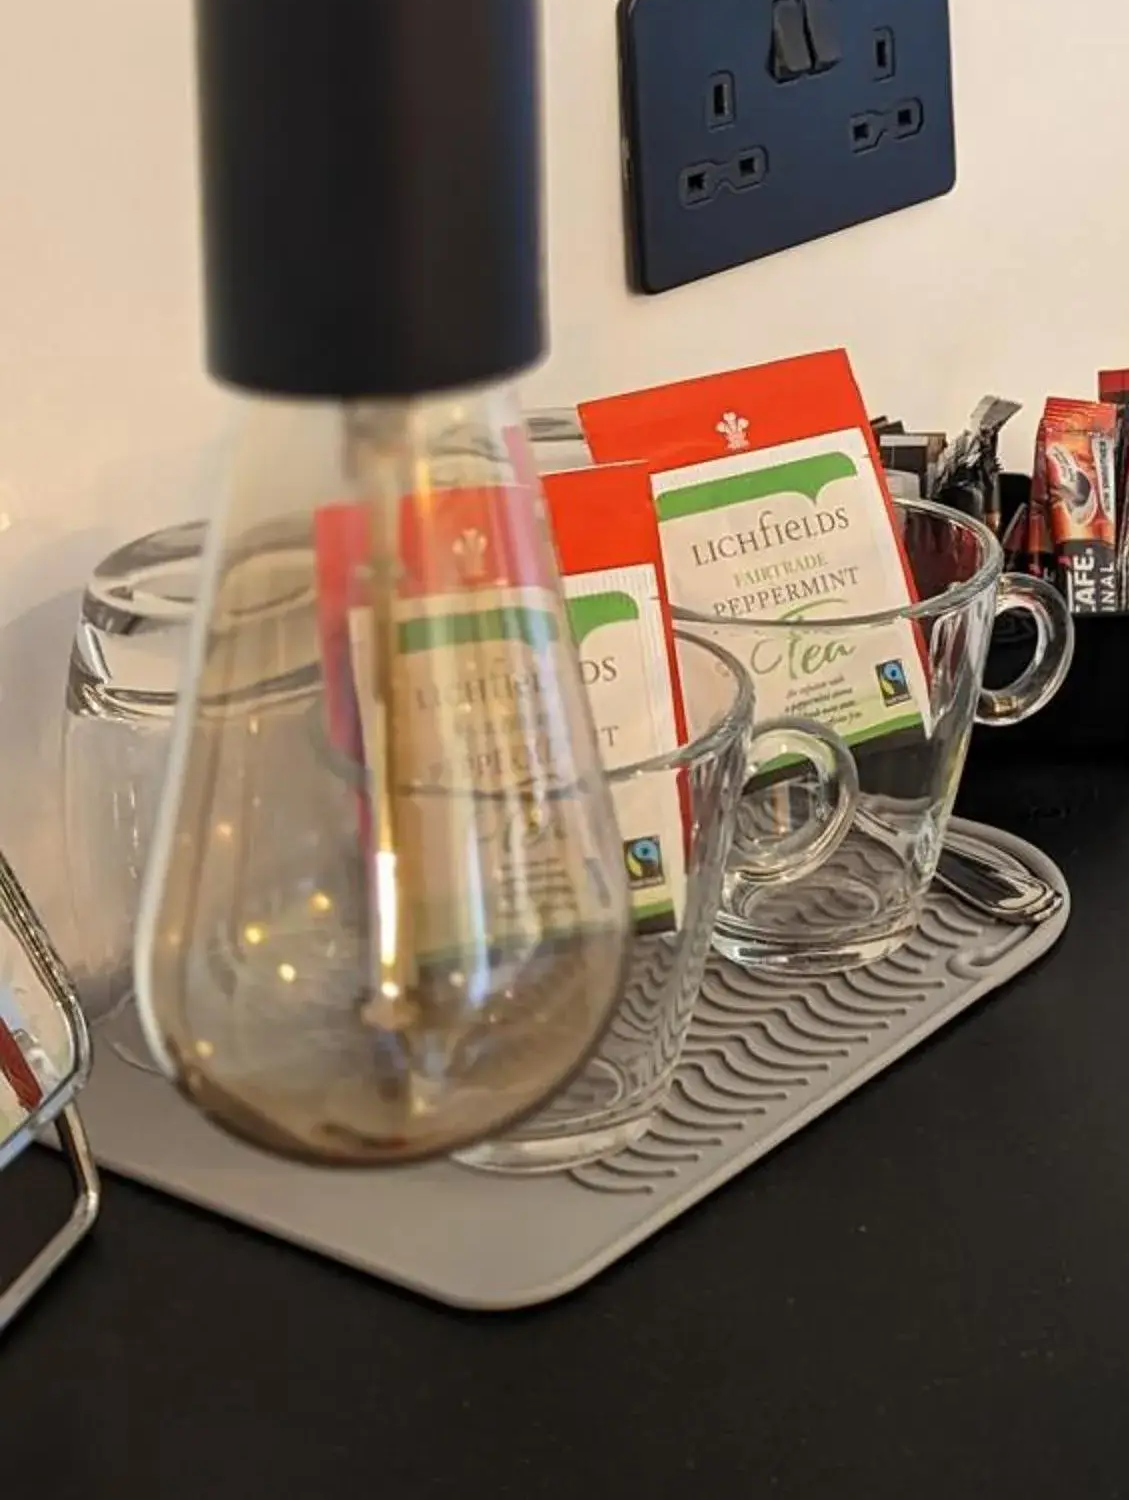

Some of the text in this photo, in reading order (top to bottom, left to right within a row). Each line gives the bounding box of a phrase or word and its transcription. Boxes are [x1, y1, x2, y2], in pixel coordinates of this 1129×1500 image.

[713, 566, 860, 617] PEPPERMINT
[733, 553, 828, 588] FAIRTRADE
[751, 598, 857, 680] Tea
